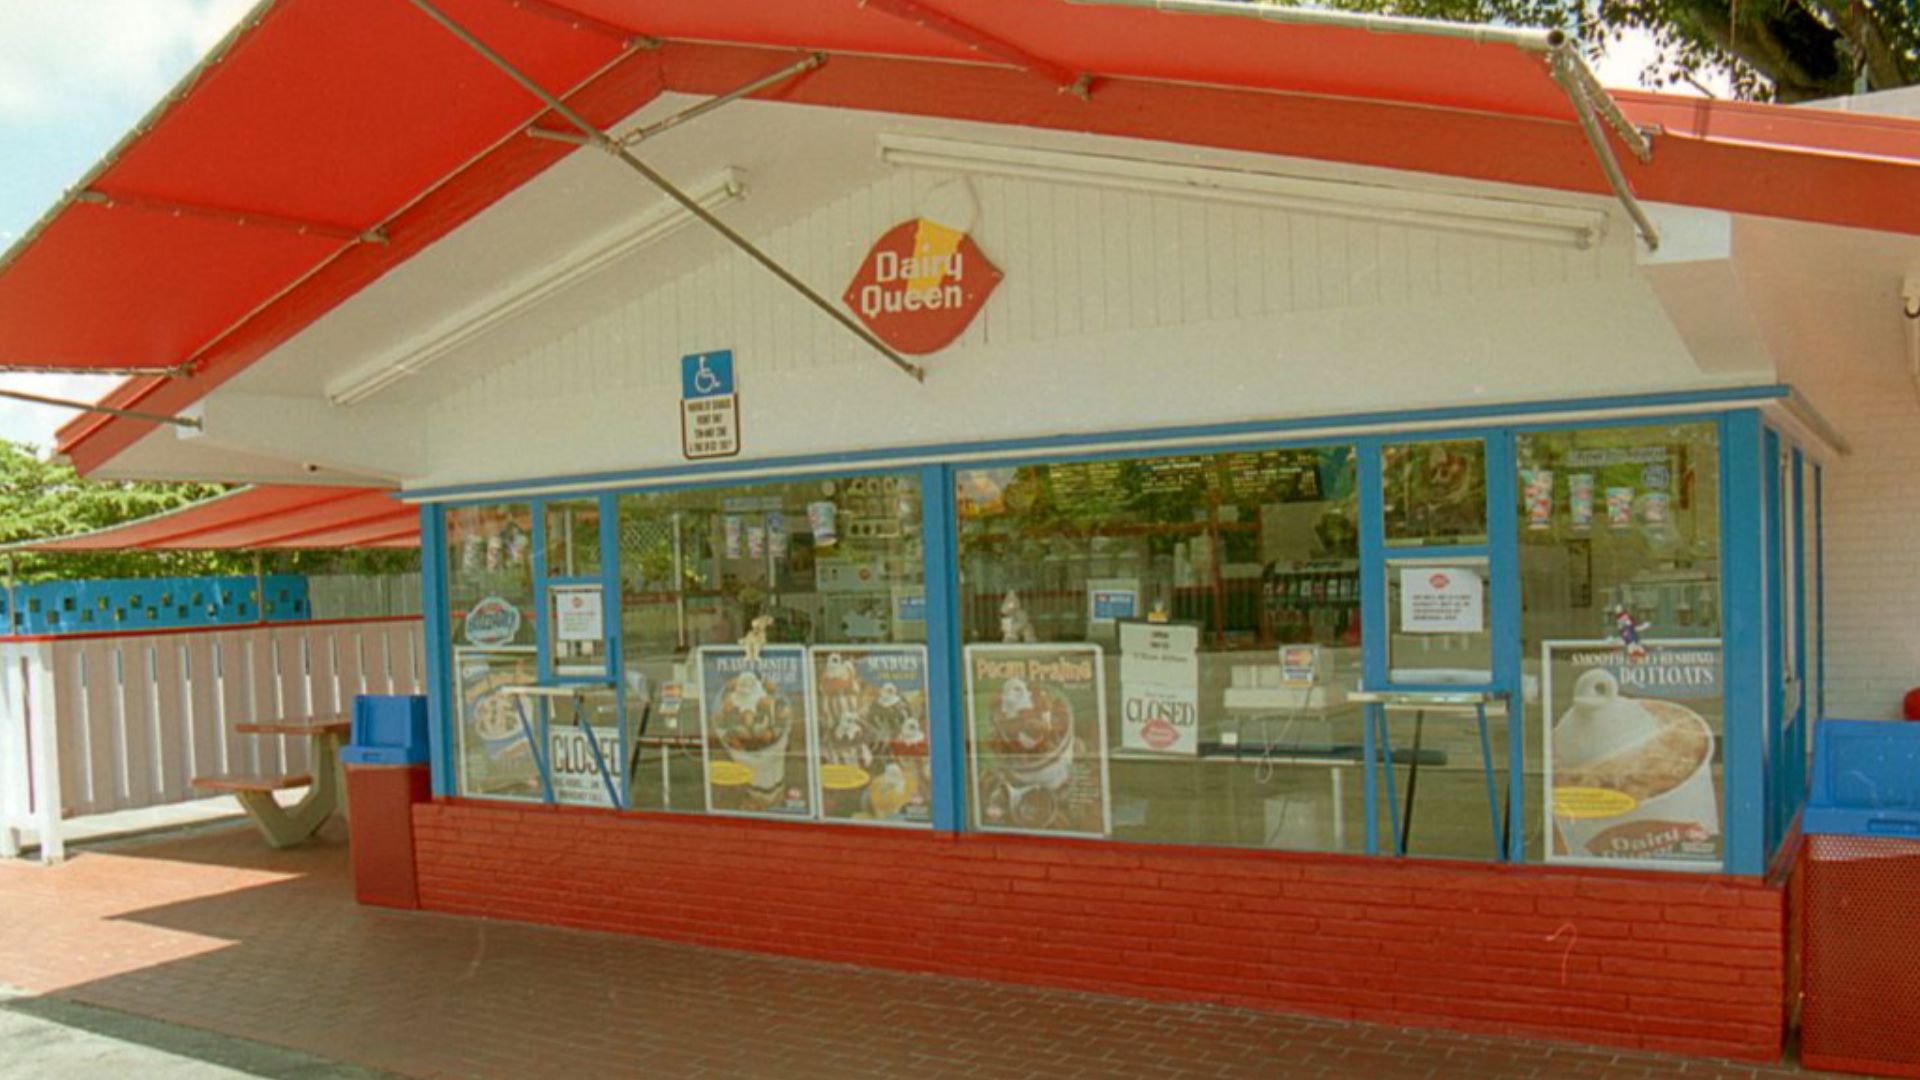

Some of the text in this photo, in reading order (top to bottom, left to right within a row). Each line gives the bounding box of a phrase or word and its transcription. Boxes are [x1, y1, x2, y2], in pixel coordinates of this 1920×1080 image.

[876, 251, 963, 282] Dairy
[861, 283, 963, 318] Queen
[1126, 697, 1195, 727] CLOSED
